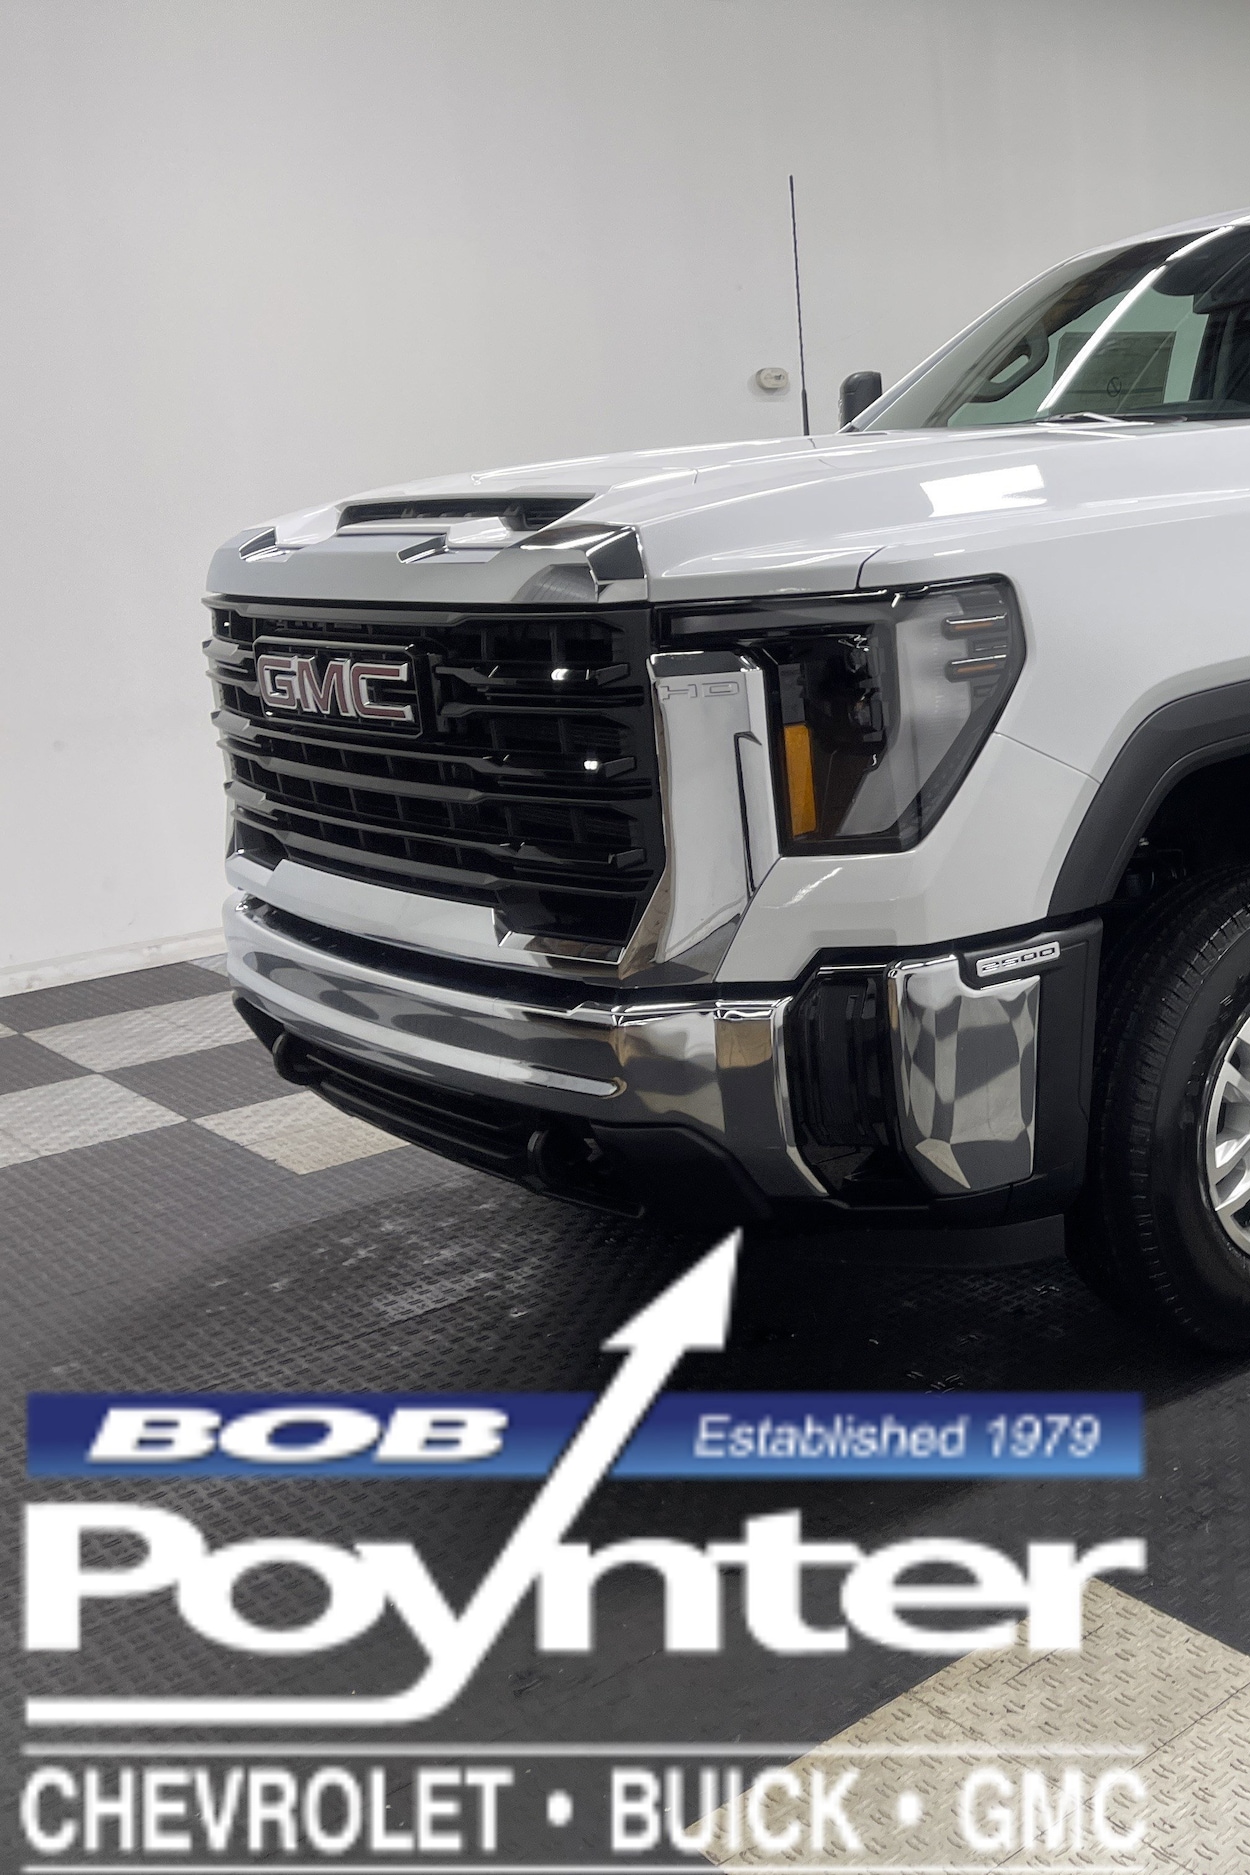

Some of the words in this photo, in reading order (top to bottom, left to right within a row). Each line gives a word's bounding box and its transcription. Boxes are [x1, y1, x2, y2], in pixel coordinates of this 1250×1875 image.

[256, 654, 408, 722] GMC
[659, 681, 740, 701] HD
[980, 946, 1056, 974] 2500
